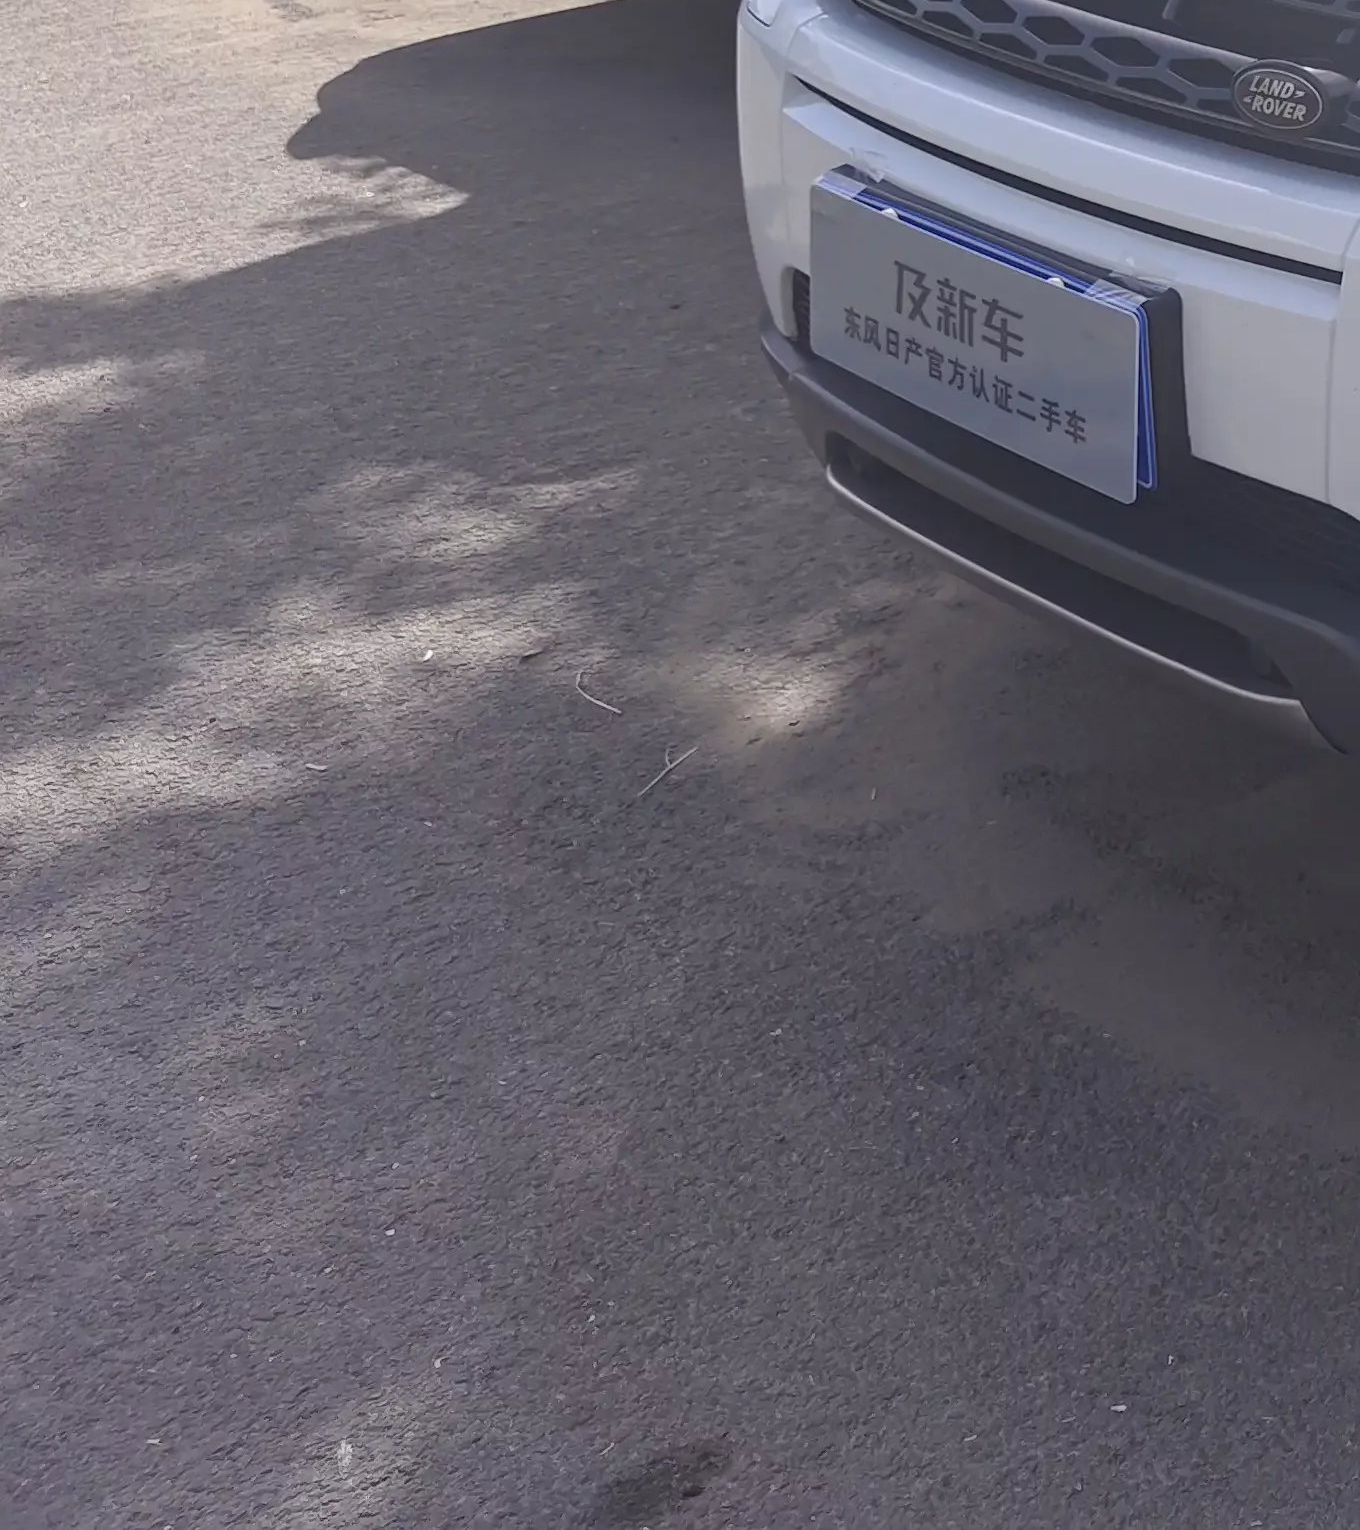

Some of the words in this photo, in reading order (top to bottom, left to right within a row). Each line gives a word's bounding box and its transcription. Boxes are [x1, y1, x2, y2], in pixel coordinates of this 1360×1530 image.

[1249, 75, 1295, 99] LAND
[1251, 95, 1307, 121] ROVER
[844, 306, 1087, 444] 东风日产官方认证二手车
